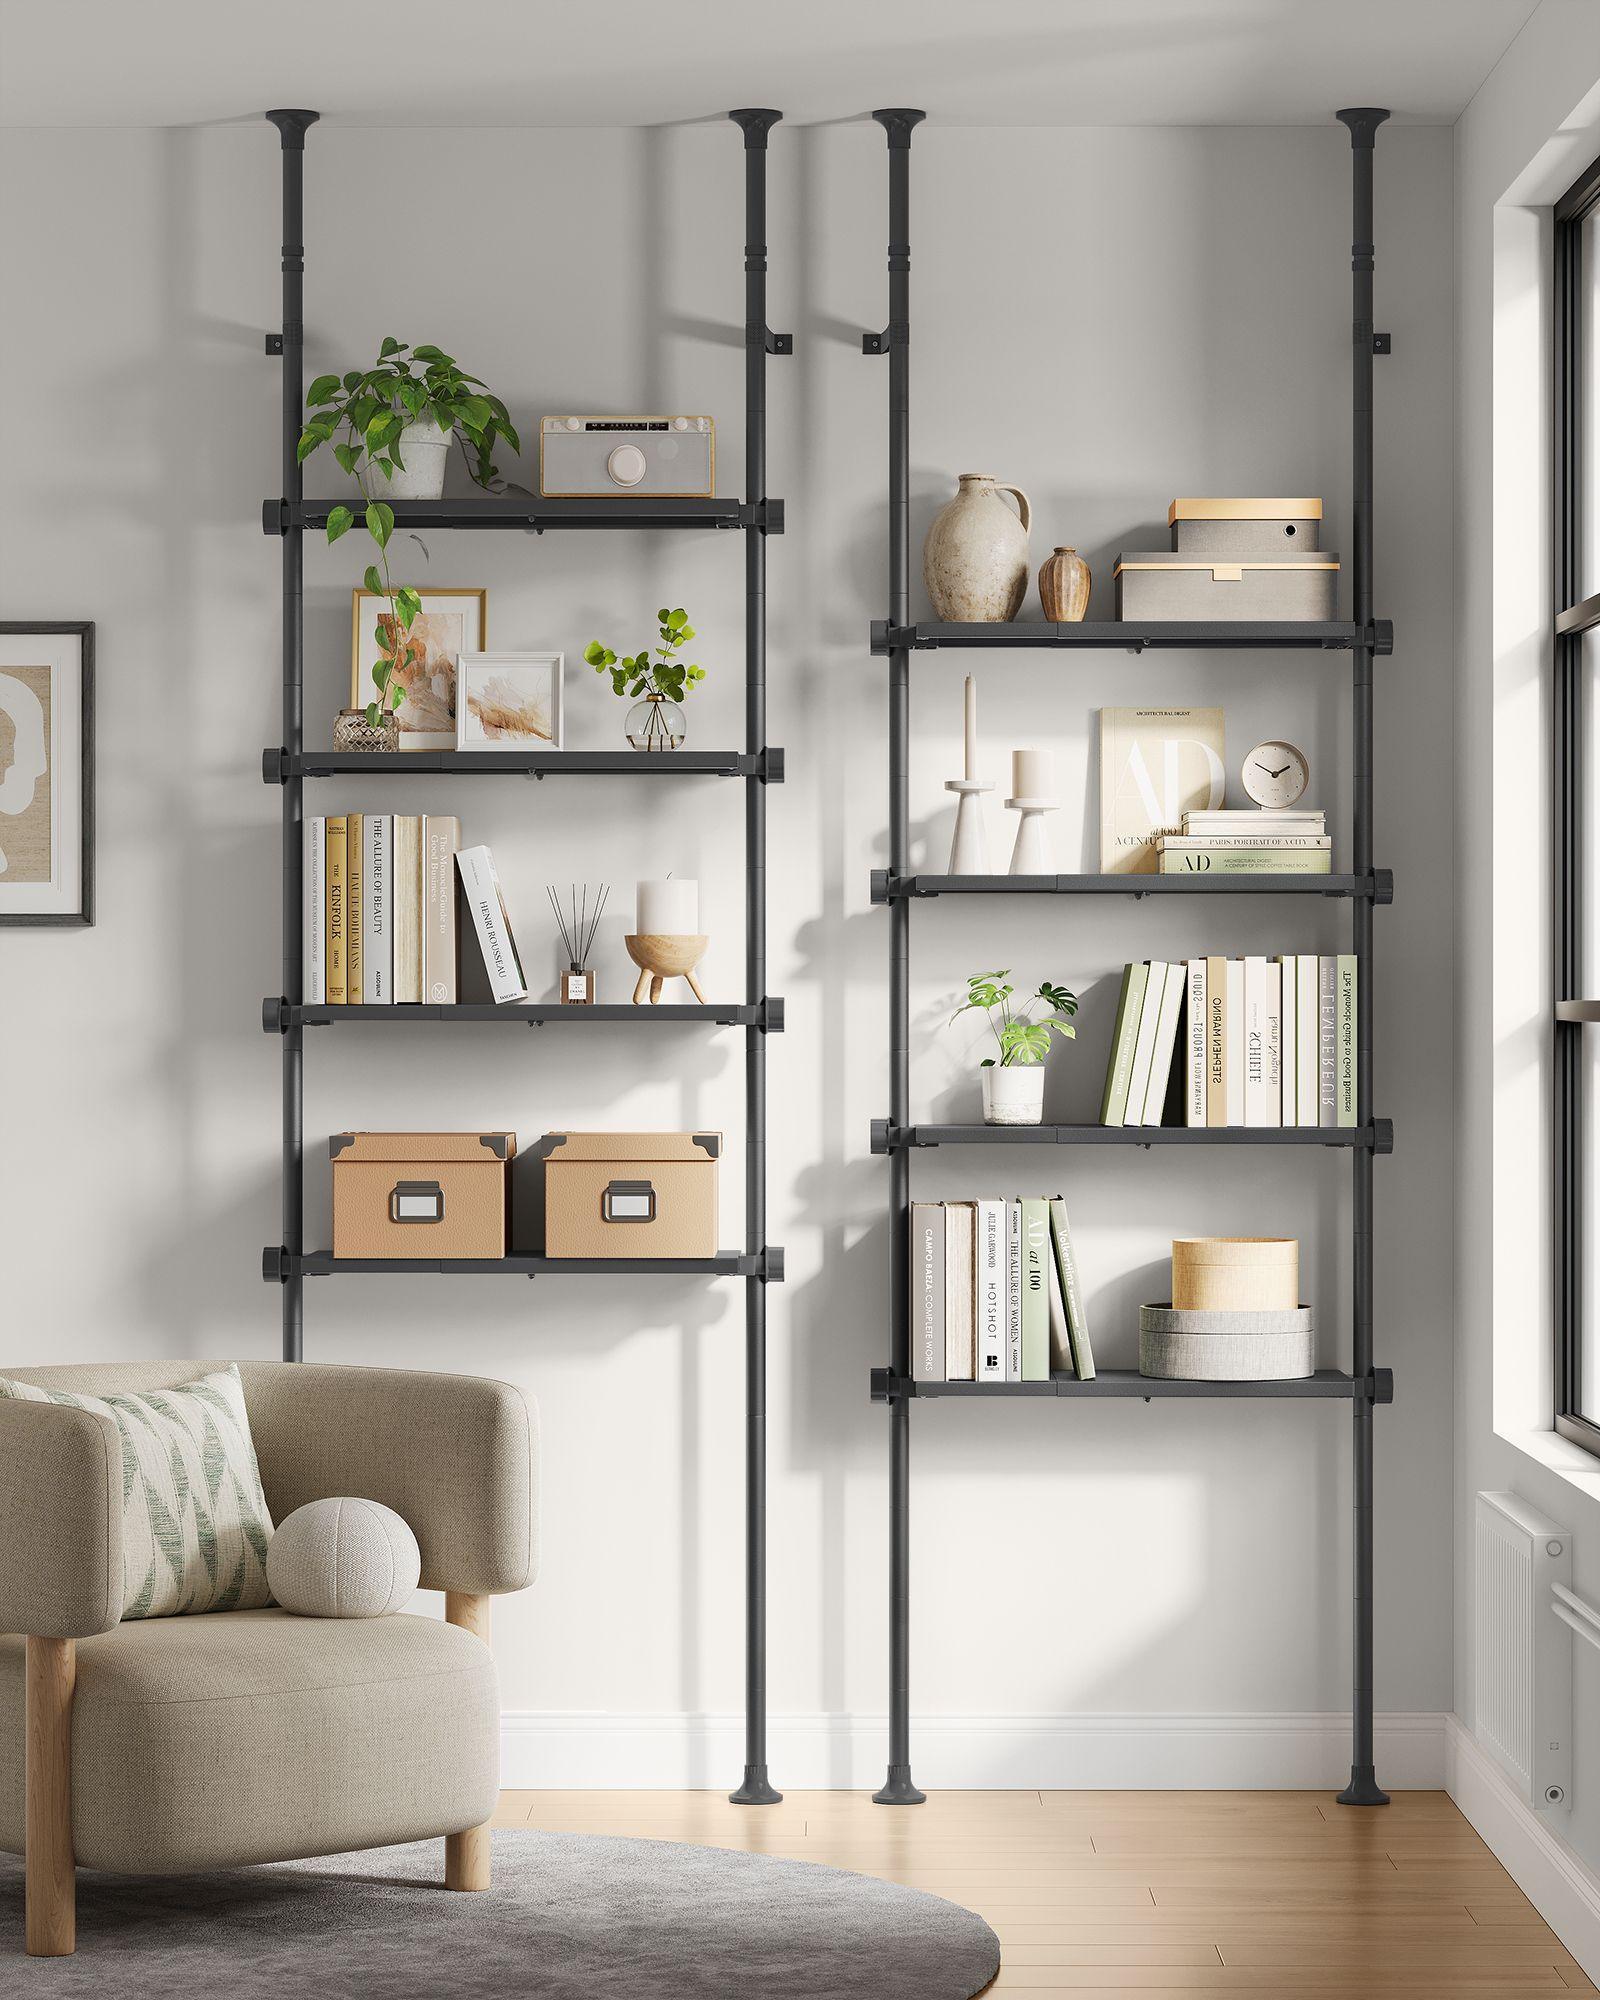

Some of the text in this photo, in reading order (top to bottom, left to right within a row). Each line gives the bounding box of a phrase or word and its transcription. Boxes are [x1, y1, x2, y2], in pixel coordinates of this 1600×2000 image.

[1103, 739, 1226, 826] AD
[440, 834, 448, 853] The
[1123, 836, 1161, 846] CENTU
[1160, 827, 1177, 836] 100
[373, 818, 382, 935] THE ALLURE OF BEAUTY
[431, 834, 439, 903] Good Business
[1180, 855, 1211, 872] AD
[331, 885, 342, 940] KINFOLK
[351, 872, 360, 970] HAUTE BOHEMIANS
[440, 924, 448, 934] to
[479, 900, 507, 979] HENRI ROUSSEAU
[1010, 1240, 1019, 1258] THE
[1028, 1215, 1044, 1291] AD at 100
[988, 1211, 996, 1339] JULIE GARWOOD HOTSHOT
[1010, 1259, 1019, 1294] ALLURE
[925, 1228, 933, 1372] CAMPO BAEZA: COMPLETE WORKS
[1010, 1295, 1019, 1307] OF
[1010, 1308, 1019, 1343] WOMEN
